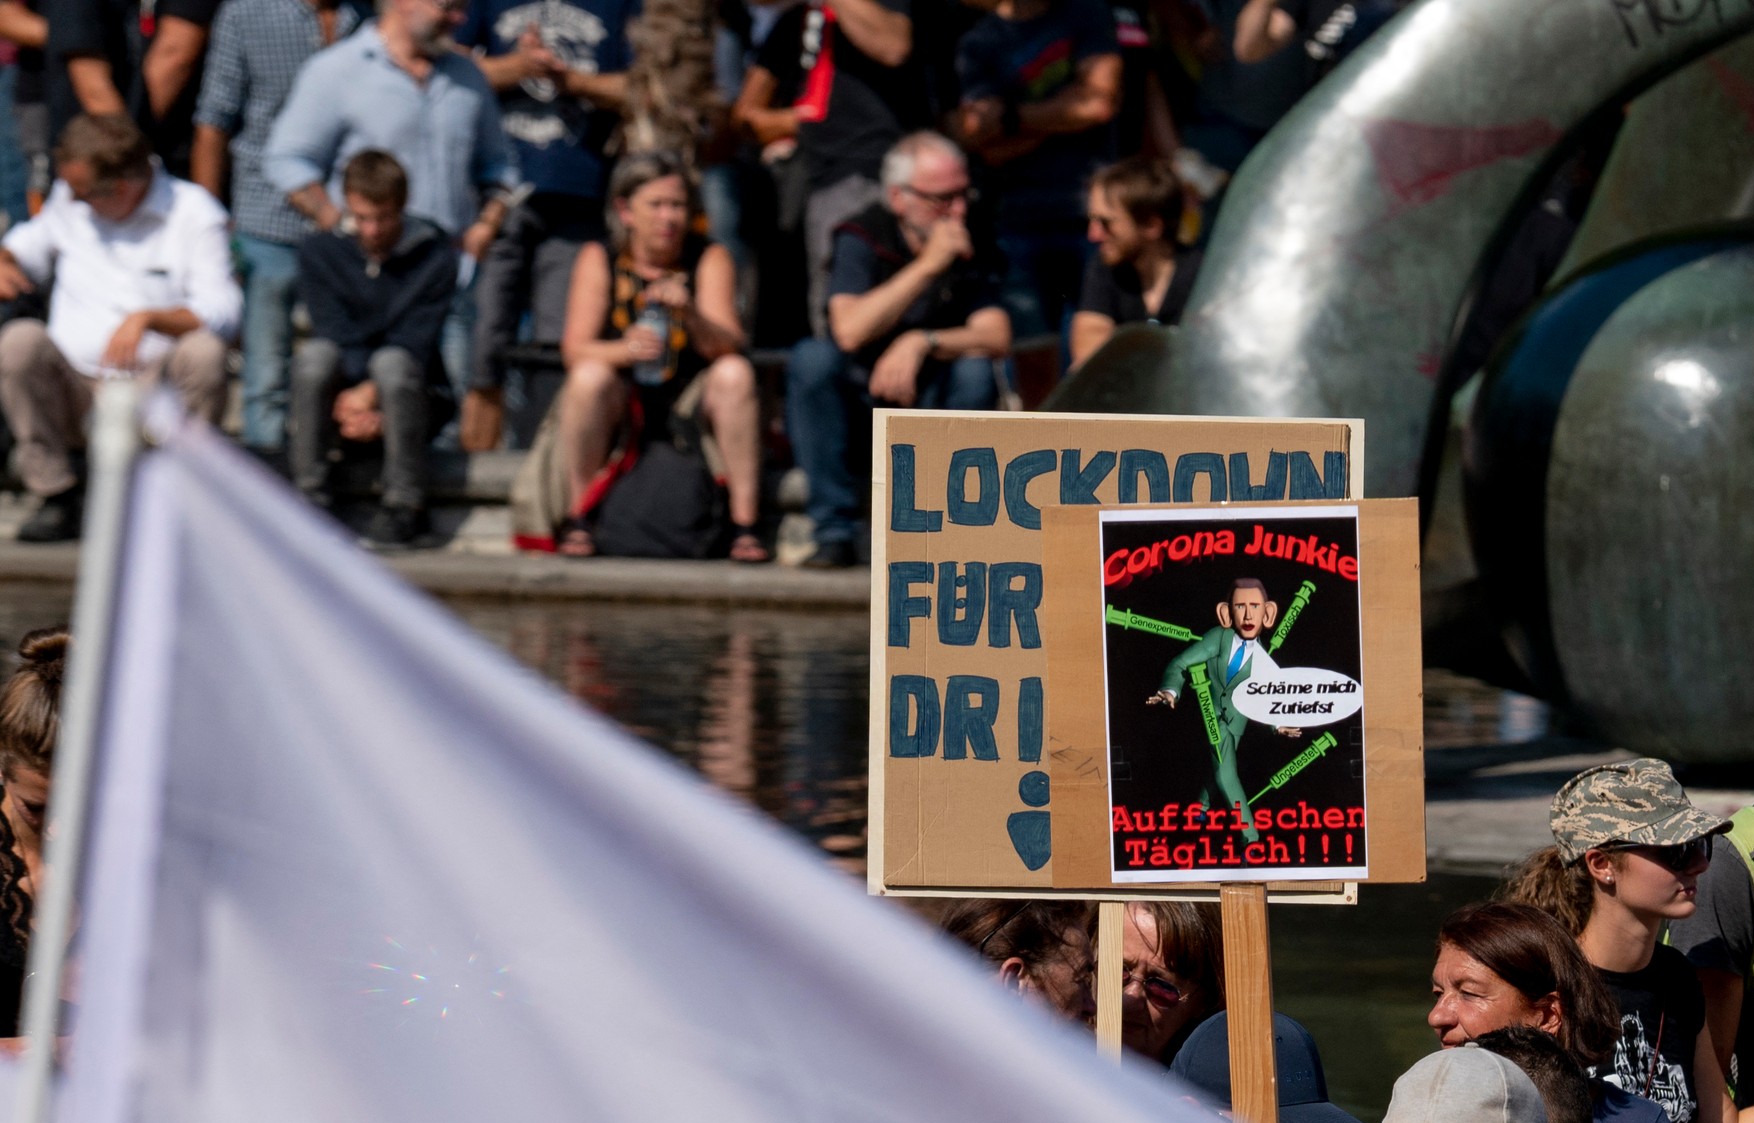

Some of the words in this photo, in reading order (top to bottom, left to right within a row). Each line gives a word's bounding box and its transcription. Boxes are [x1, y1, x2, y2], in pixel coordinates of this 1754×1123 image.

[889, 443, 1348, 533] LOCKDOWN
[1103, 529, 1236, 588] Corona
[1244, 524, 1359, 581] Junkie
[1129, 615, 1191, 639] Genexperiment
[1274, 603, 1302, 641] Toxisch
[1246, 681, 1312, 695] Schäme
[1316, 680, 1357, 694] mich
[1269, 700, 1335, 715] Zutiefst
[1271, 746, 1319, 787] Ungetestet
[1112, 801, 1366, 833] Auffrischen
